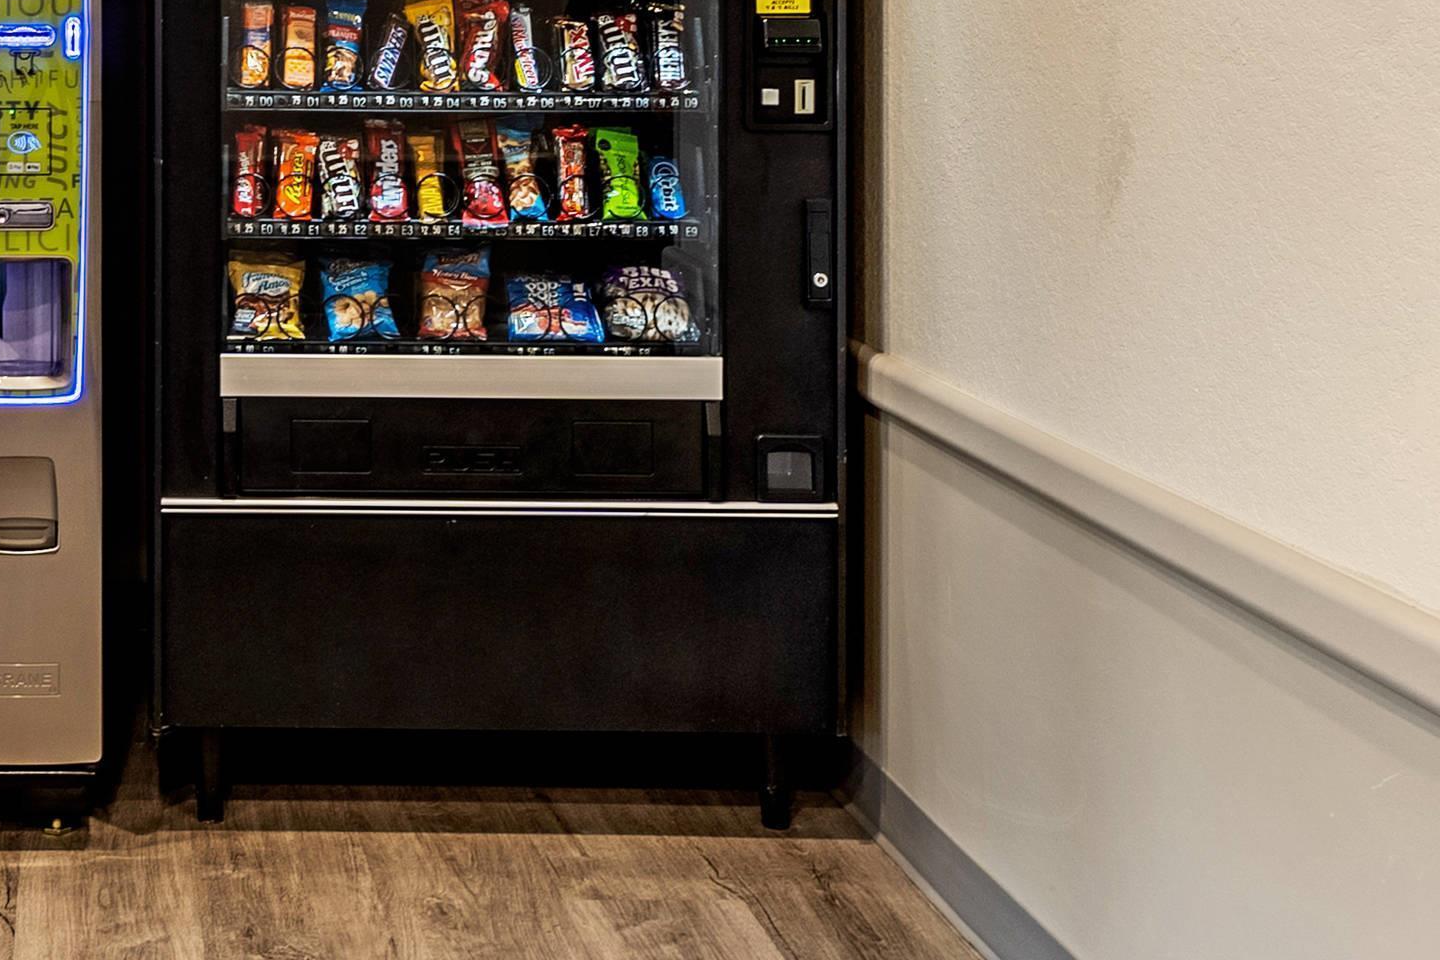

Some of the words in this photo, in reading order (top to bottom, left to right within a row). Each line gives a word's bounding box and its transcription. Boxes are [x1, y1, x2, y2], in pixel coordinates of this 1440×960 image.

[307, 96, 320, 107] D1
[353, 96, 366, 107] D2
[399, 97, 413, 108] D3
[446, 97, 460, 108] D4
[493, 97, 507, 108] D5
[261, 224, 273, 235] E0
[308, 224, 320, 235] E1
[354, 224, 367, 235] E2
[401, 224, 414, 235] E3
[448, 224, 461, 235] E4
[541, 224, 555, 236] E6
[636, 226, 648, 236] E8
[685, 226, 698, 237] E9
[619, 277, 679, 293] TEXAS
